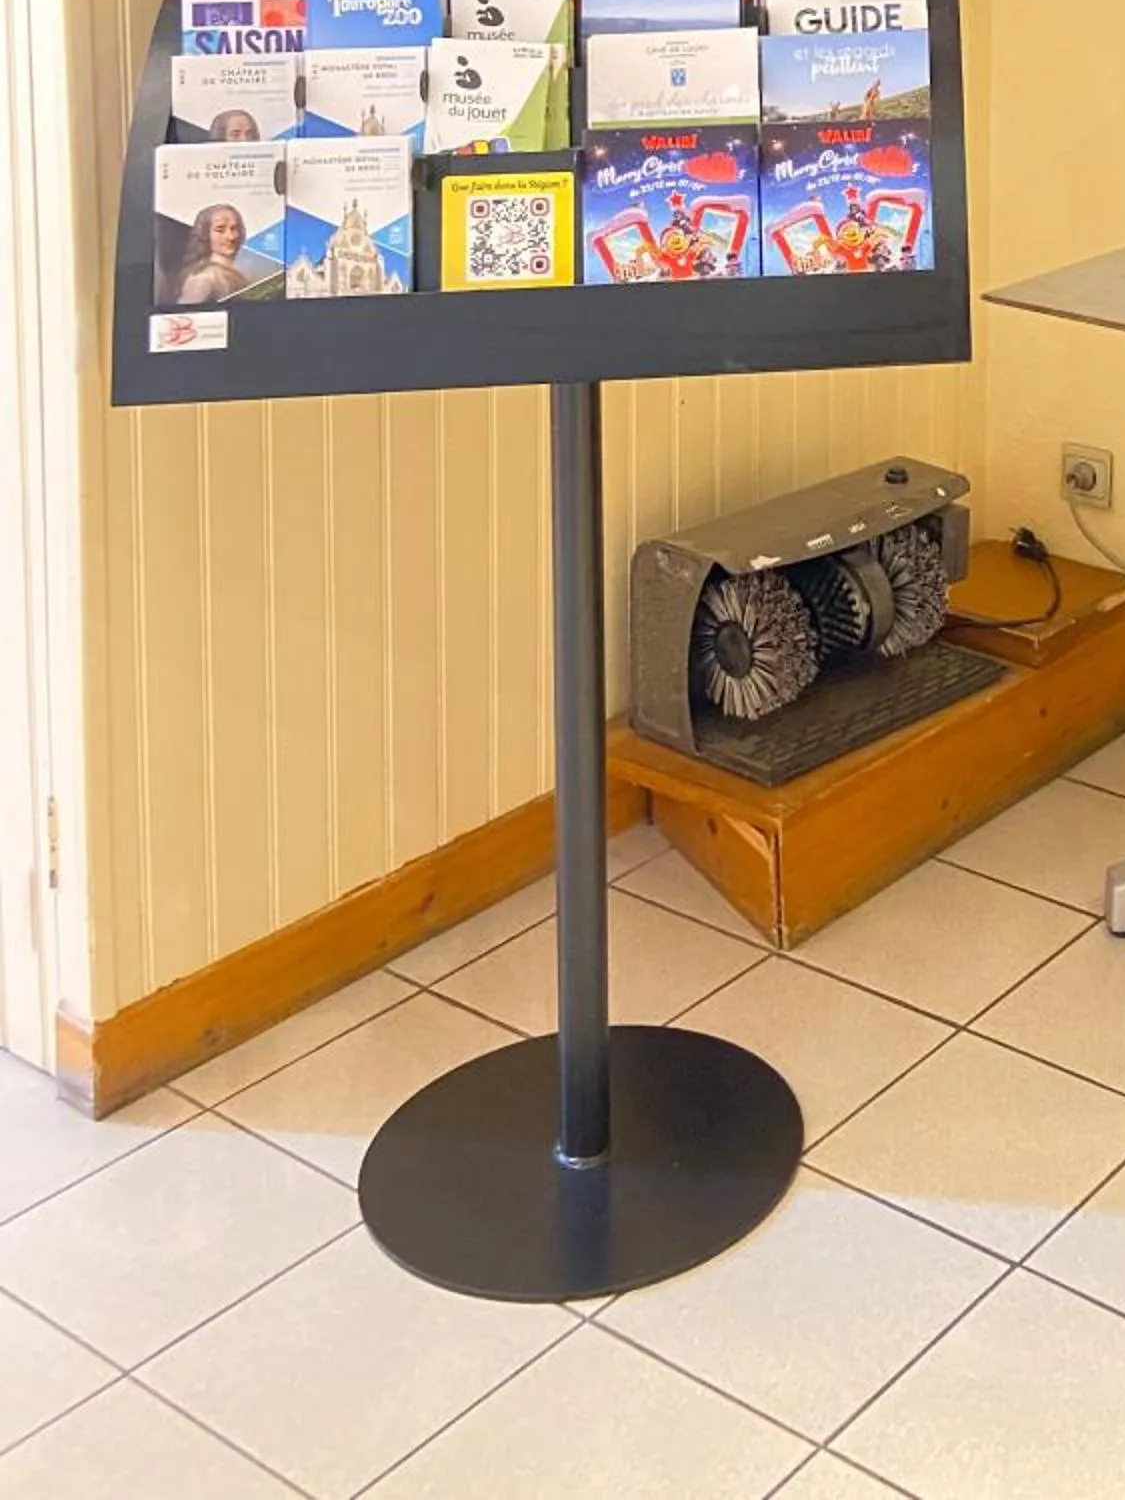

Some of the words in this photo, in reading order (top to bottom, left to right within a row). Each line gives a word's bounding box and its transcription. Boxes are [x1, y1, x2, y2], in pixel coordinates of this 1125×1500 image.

[382, 7, 423, 26] ZOO
[794, 4, 903, 35] GUIDE
[195, 29, 304, 55] SAISON
[467, 29, 515, 41] musée
[443, 92, 493, 105] musée
[448, 106, 465, 117] du
[467, 107, 508, 122] jouet
